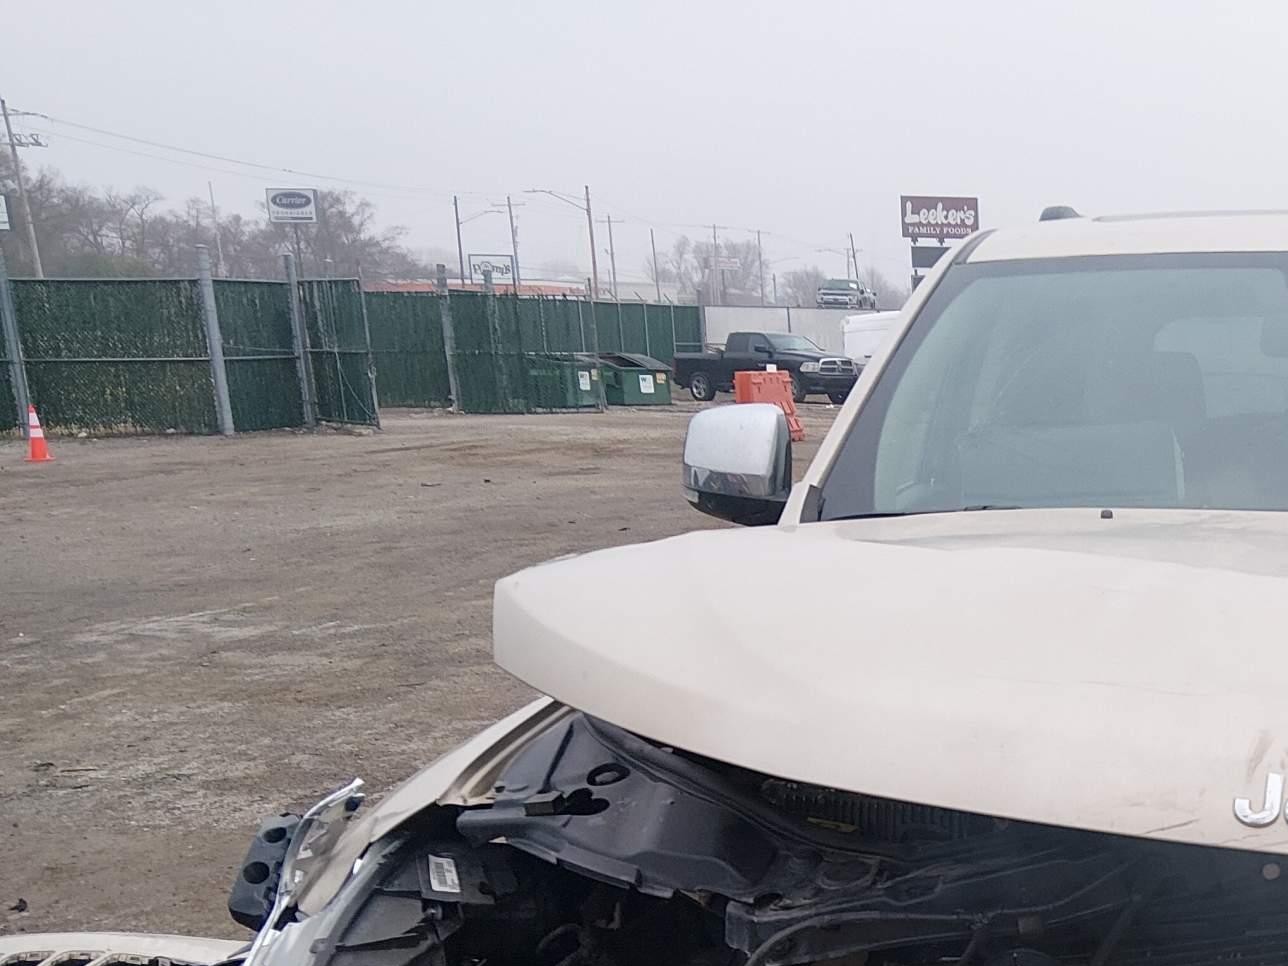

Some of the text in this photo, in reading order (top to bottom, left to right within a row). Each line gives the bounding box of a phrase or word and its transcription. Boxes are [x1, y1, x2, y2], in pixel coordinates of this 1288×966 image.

[904, 200, 975, 226] Leeker's
[908, 226, 972, 235] FAMILY FOODS
